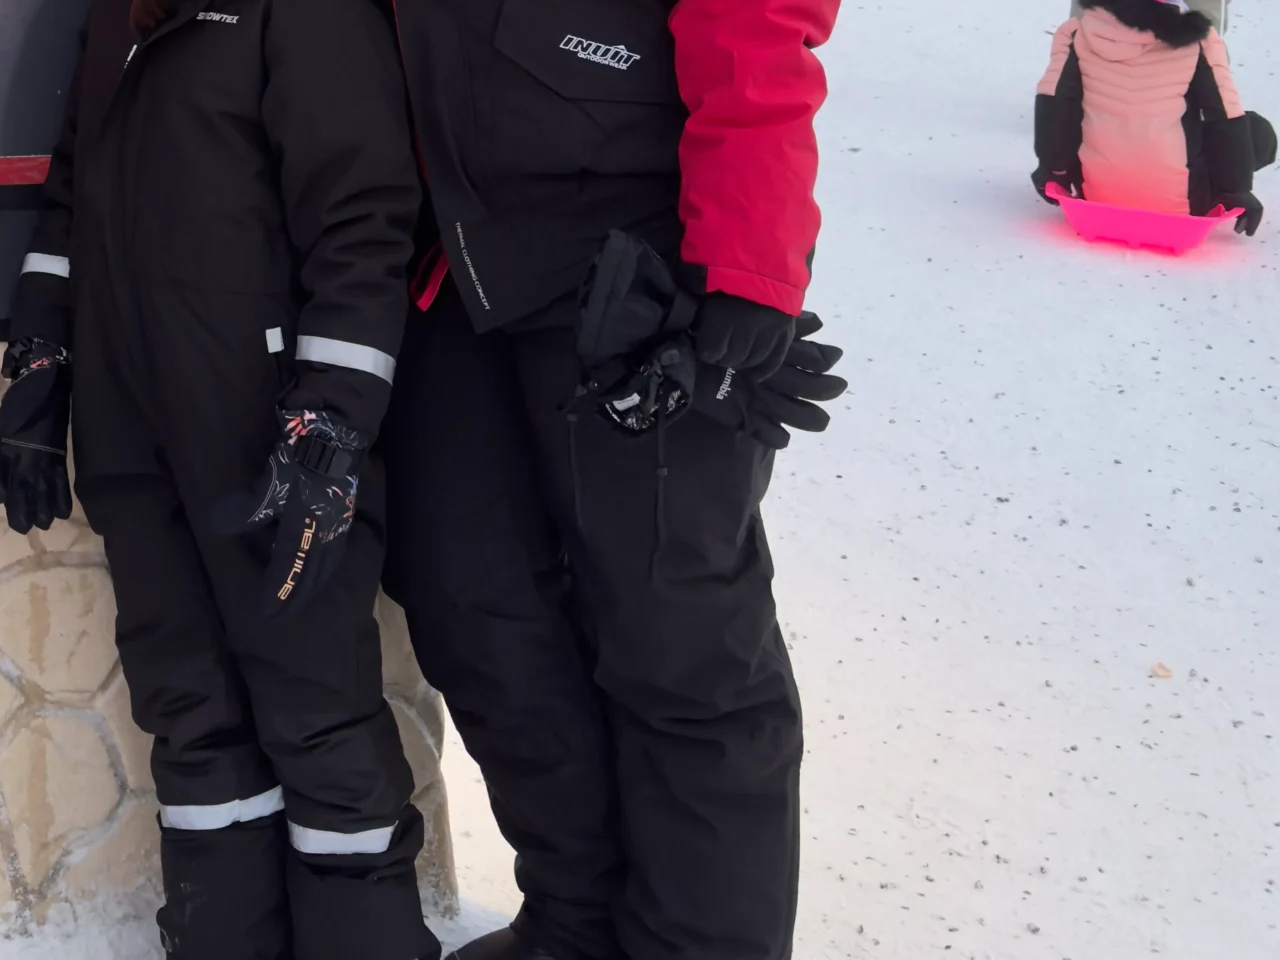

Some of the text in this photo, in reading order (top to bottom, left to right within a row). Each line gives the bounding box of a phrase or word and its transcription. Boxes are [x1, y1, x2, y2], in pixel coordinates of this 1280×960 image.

[559, 34, 641, 67] INUIT
[577, 52, 609, 65] OUTDOOR
[455, 221, 491, 311] THERMAL CLOTHING CONCEPT
[716, 367, 736, 400] lumbia
